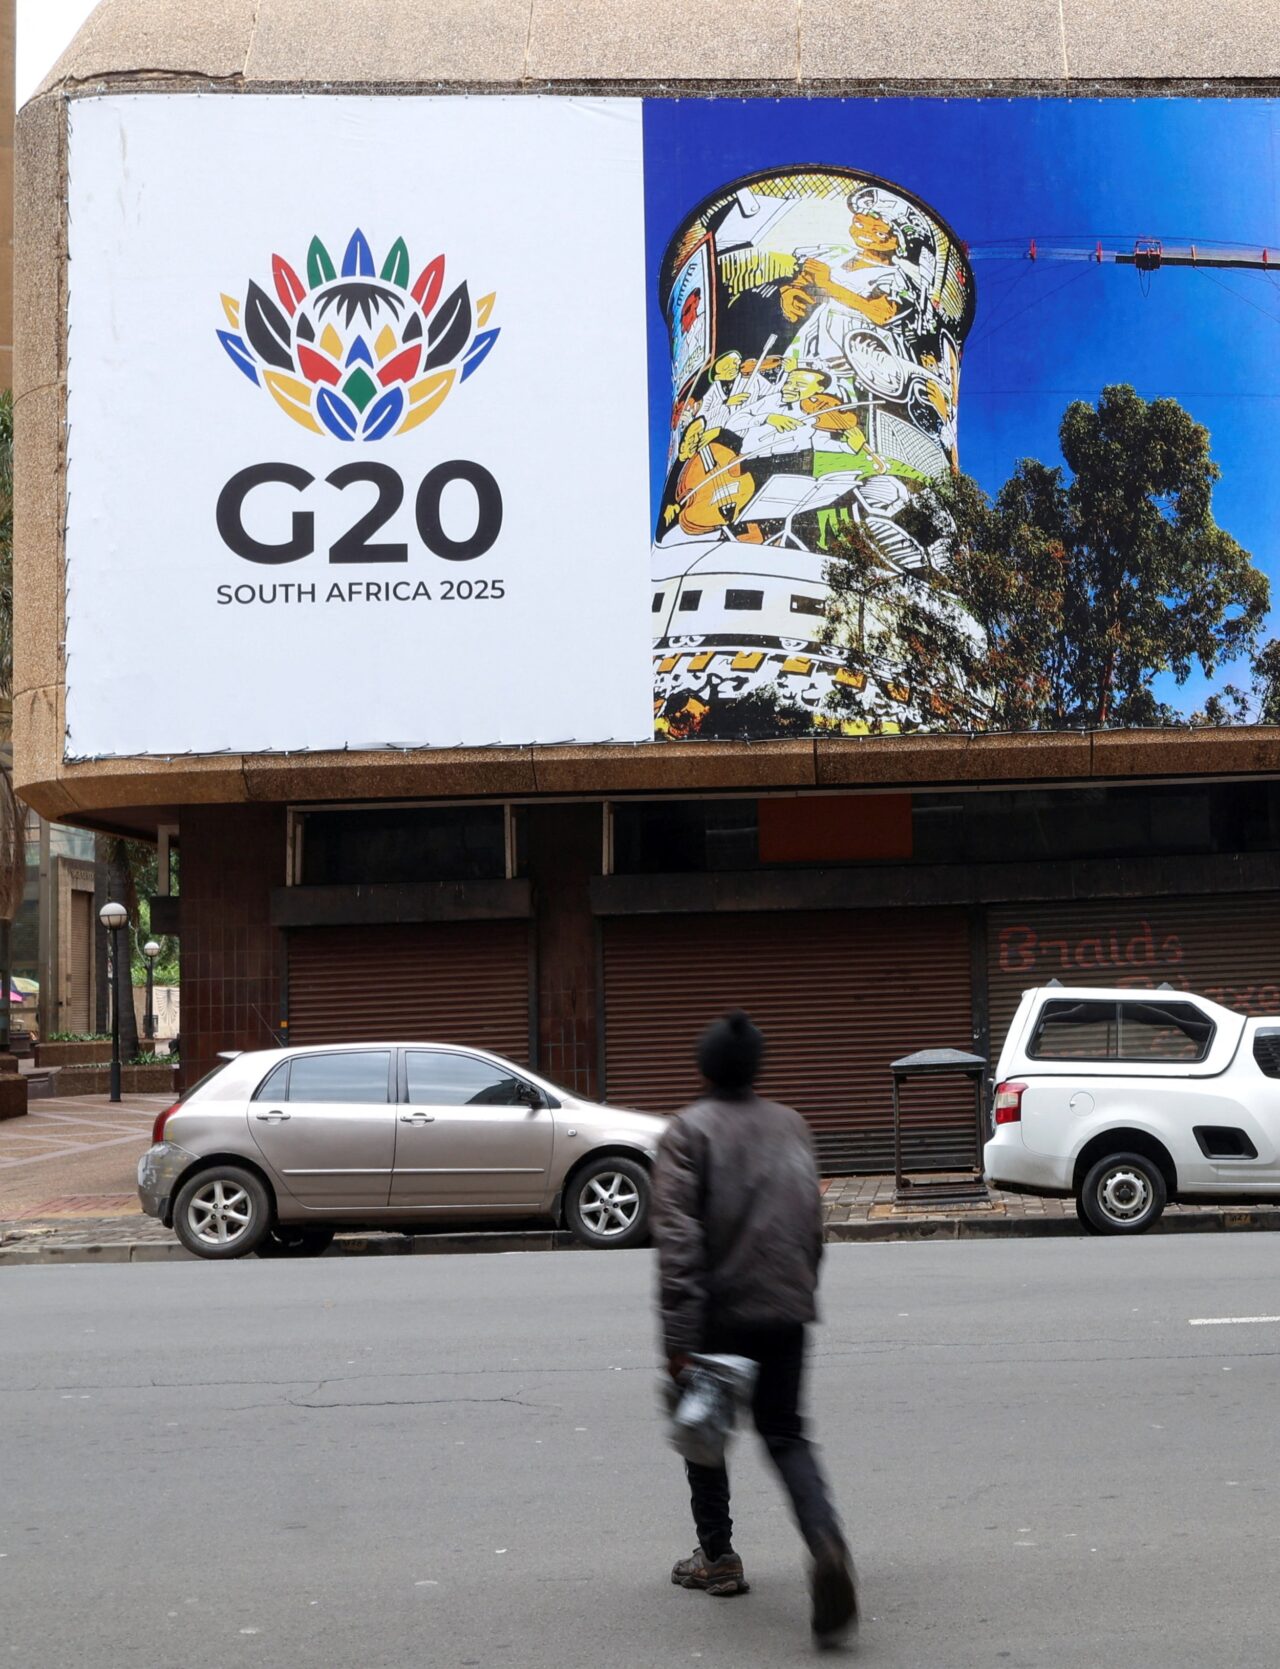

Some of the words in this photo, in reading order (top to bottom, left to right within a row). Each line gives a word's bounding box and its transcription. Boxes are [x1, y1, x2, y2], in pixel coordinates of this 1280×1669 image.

[216, 459, 503, 565] G20
[217, 582, 317, 605] SOUTH
[325, 581, 432, 603] AFRICA
[440, 579, 505, 600] 2025
[998, 921, 1184, 973] Braids
